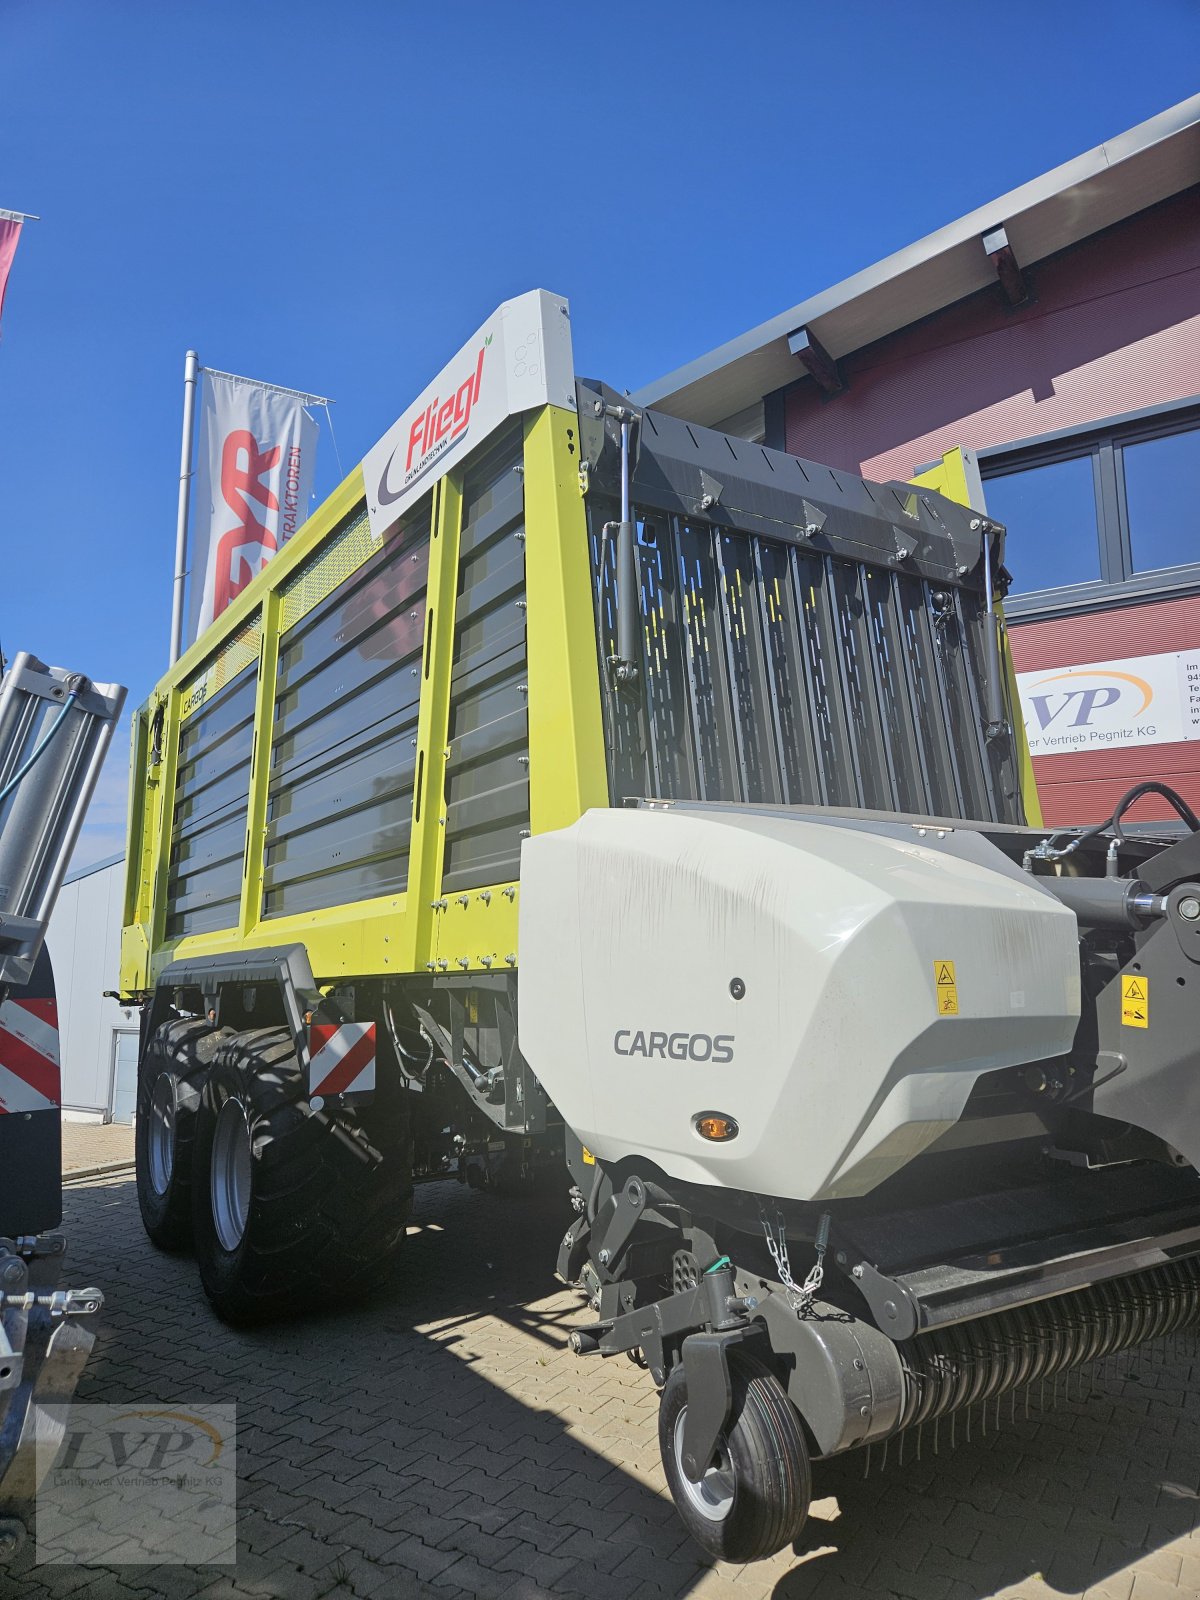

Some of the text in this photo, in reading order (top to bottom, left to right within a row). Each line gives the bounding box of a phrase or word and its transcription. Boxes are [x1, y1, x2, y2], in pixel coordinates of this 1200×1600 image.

[405, 346, 485, 473] Fliegl
[281, 446, 302, 542] TRAKTOREN
[213, 429, 280, 623] EYR
[1187, 674, 1200, 682] 94
[1188, 684, 1200, 692] Te
[1024, 687, 1121, 731] VP
[1189, 695, 1200, 703] Fa
[1190, 706, 1200, 714] in
[1028, 725, 1157, 748] er Vertrieb Pegnitz KG
[614, 1029, 735, 1064] CARGOS
